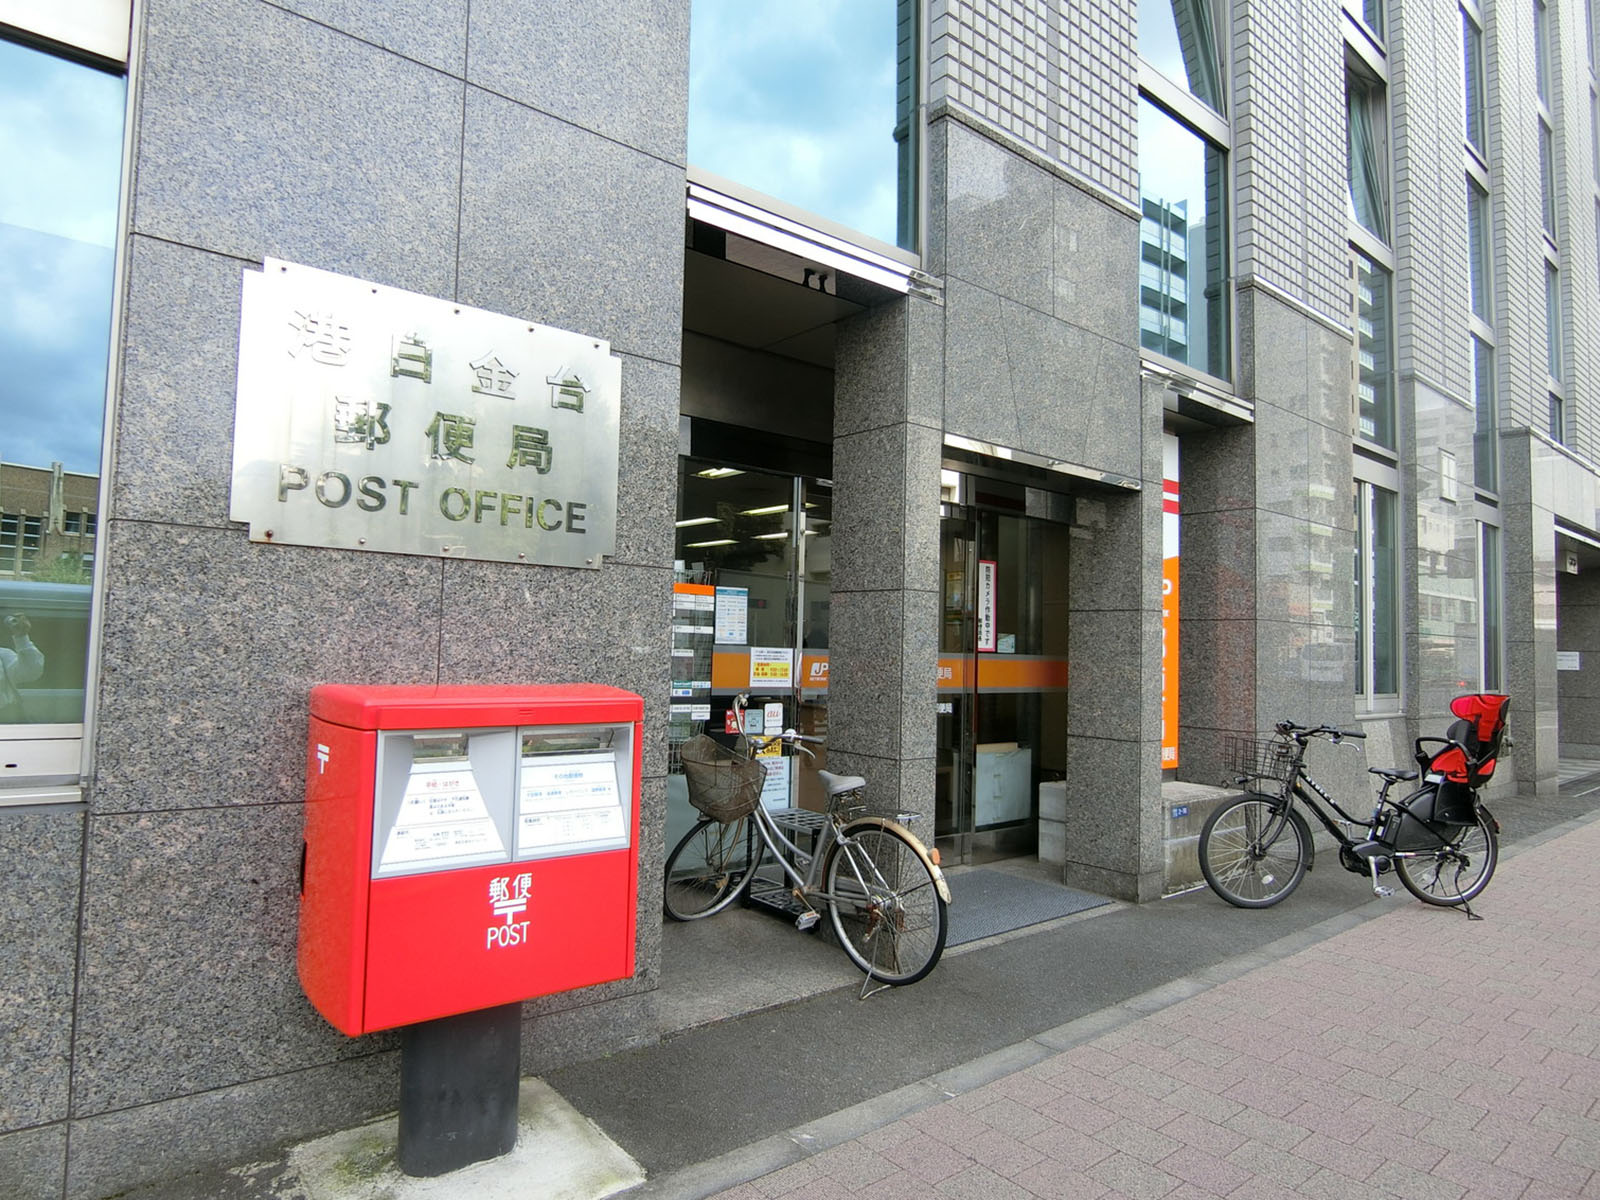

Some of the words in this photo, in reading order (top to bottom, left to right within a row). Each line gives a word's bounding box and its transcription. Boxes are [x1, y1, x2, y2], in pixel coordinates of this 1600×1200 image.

[335, 395, 554, 475] 郵便局
[278, 463, 419, 516] POST
[439, 486, 588, 534] OFFICE
[488, 873, 533, 904] 郵便
[487, 921, 531, 949] POST
